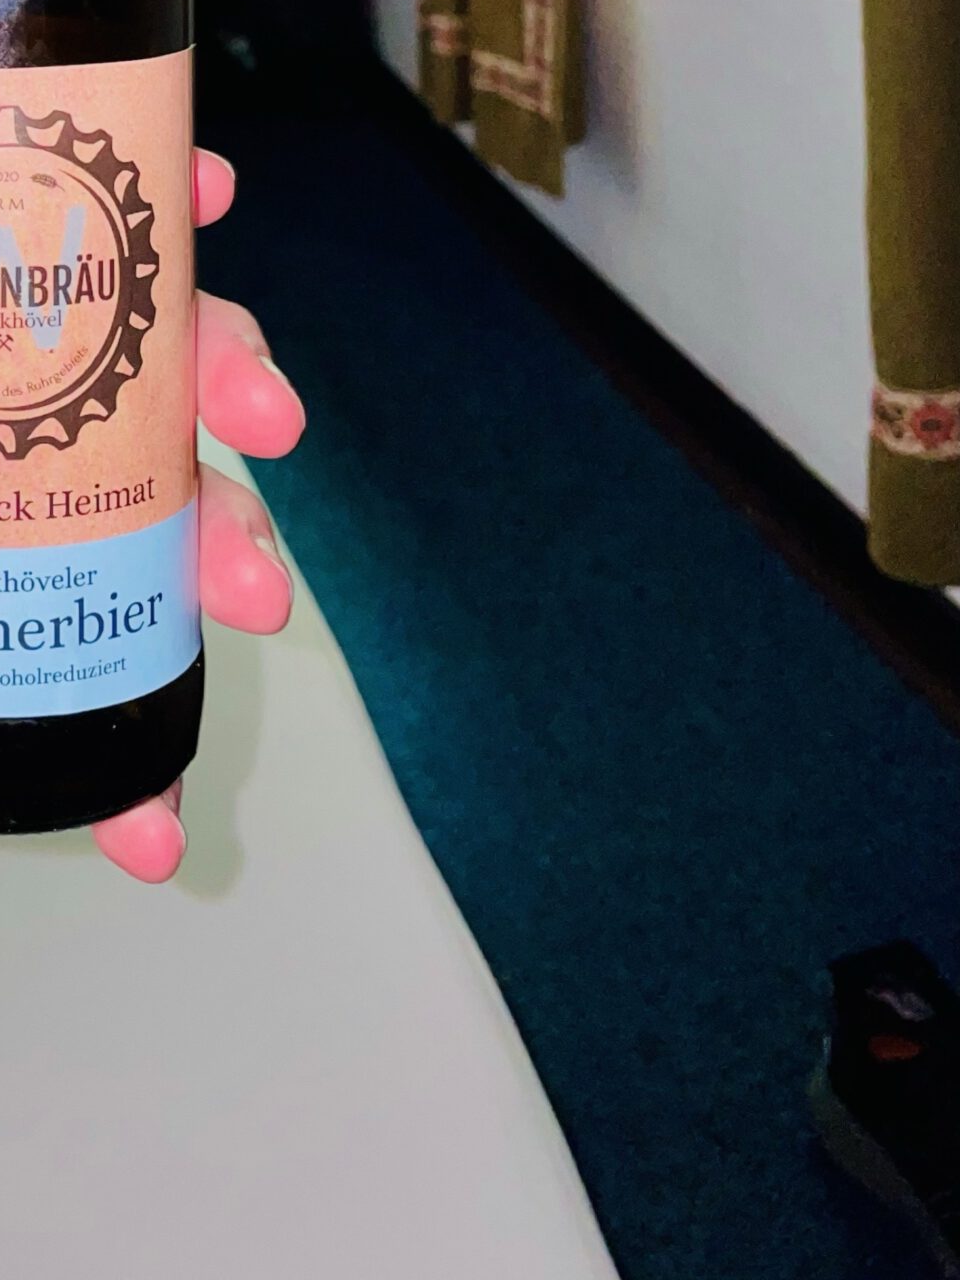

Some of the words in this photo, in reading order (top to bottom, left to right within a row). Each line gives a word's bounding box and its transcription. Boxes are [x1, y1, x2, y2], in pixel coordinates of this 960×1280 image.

[1, 386, 23, 397] des
[26, 346, 89, 393] Ruhrgebiets
[46, 475, 156, 520] Heimat
